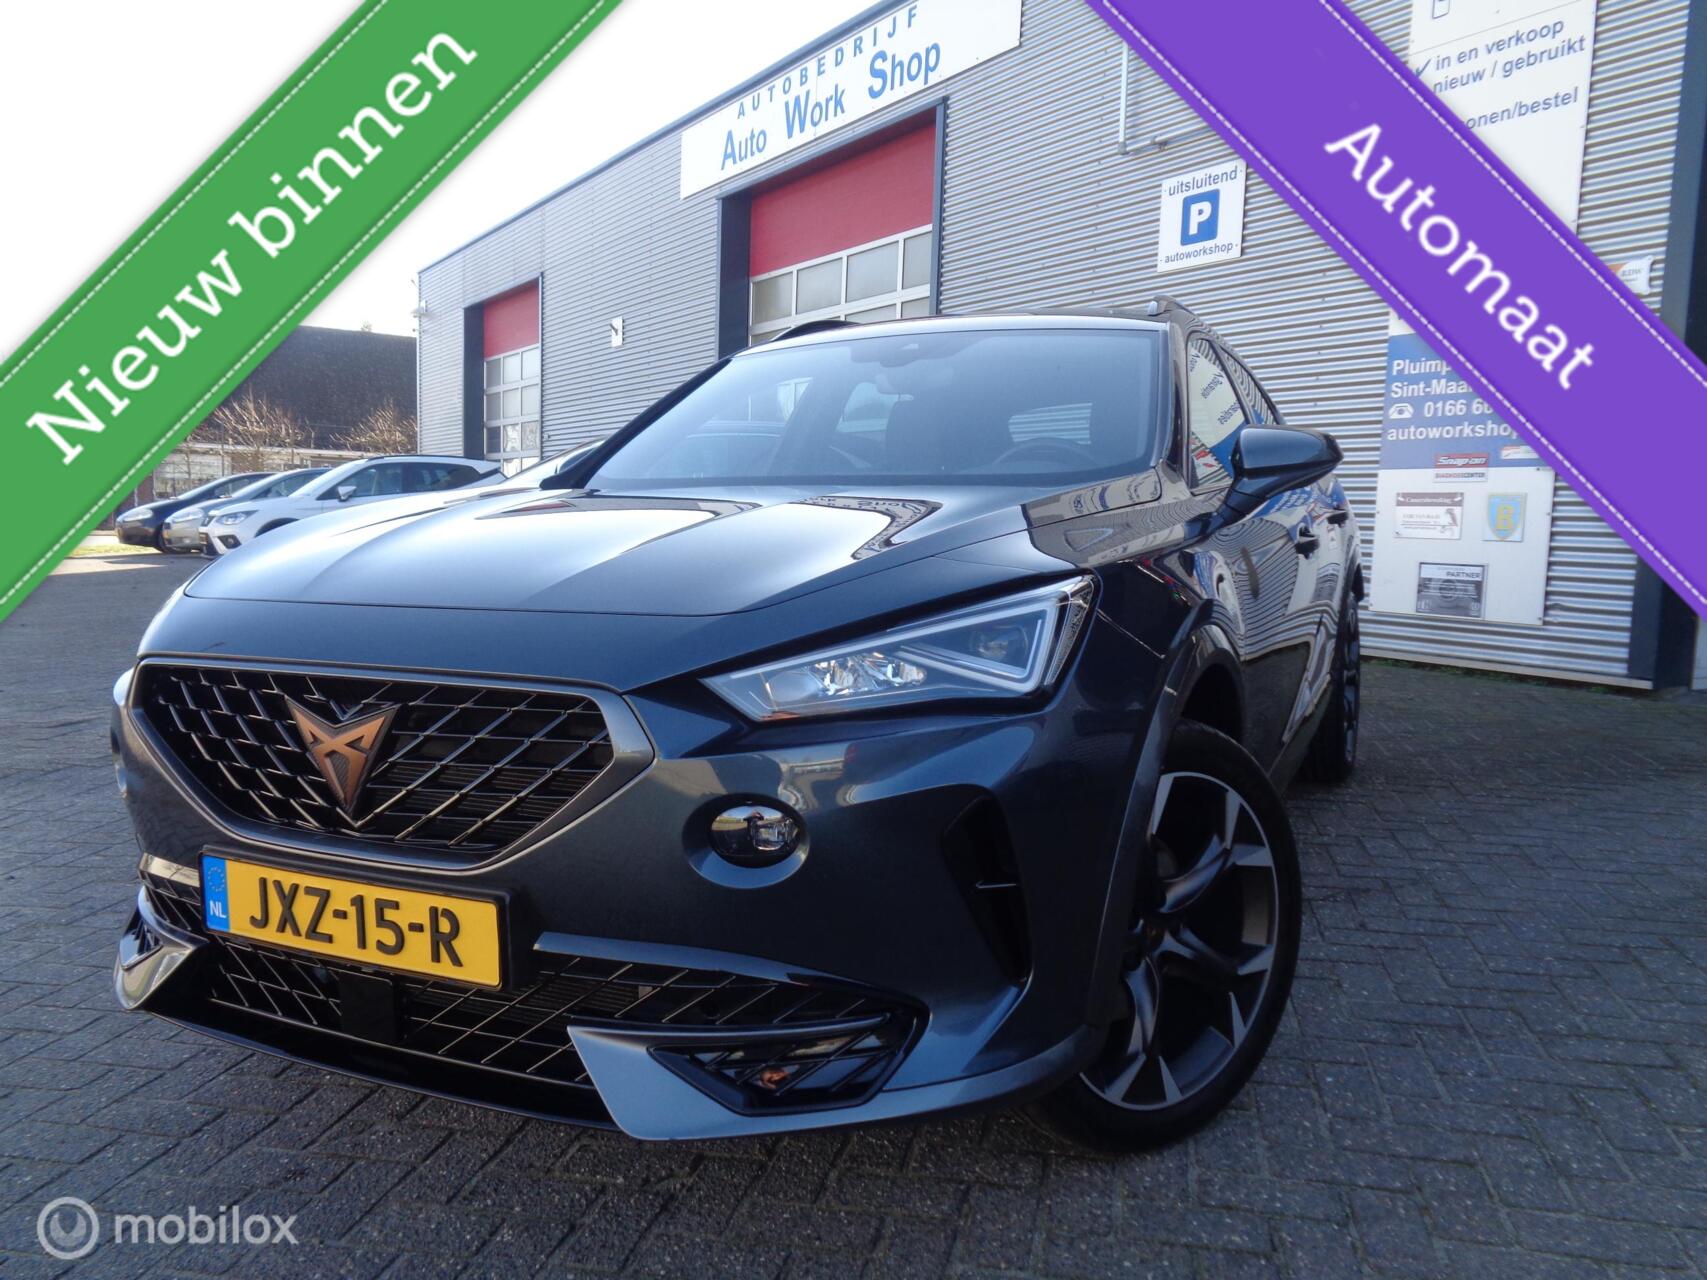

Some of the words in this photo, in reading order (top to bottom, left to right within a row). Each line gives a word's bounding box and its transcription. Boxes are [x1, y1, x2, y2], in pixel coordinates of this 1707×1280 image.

[737, 5, 918, 119] AUTOBEDRIJF
[1433, 68, 1486, 93] nieuw
[1502, 36, 1586, 78] gebruikt
[1436, 55, 1451, 71] in
[1457, 48, 1478, 64] en
[1485, 21, 1564, 55] verkoop
[721, 129, 767, 170] Auto
[784, 84, 845, 139] Work
[868, 43, 940, 99] Shop
[1462, 87, 1579, 130] onen/bestel
[1168, 166, 1238, 196] uitsluitend
[1189, 201, 1212, 236] P
[1164, 243, 1233, 263] autoworkshop
[1424, 399, 1466, 417] 0166
[1446, 571, 1481, 579] PARTNER
[209, 901, 227, 919] NL
[249, 876, 464, 968] JXZ-15-R
